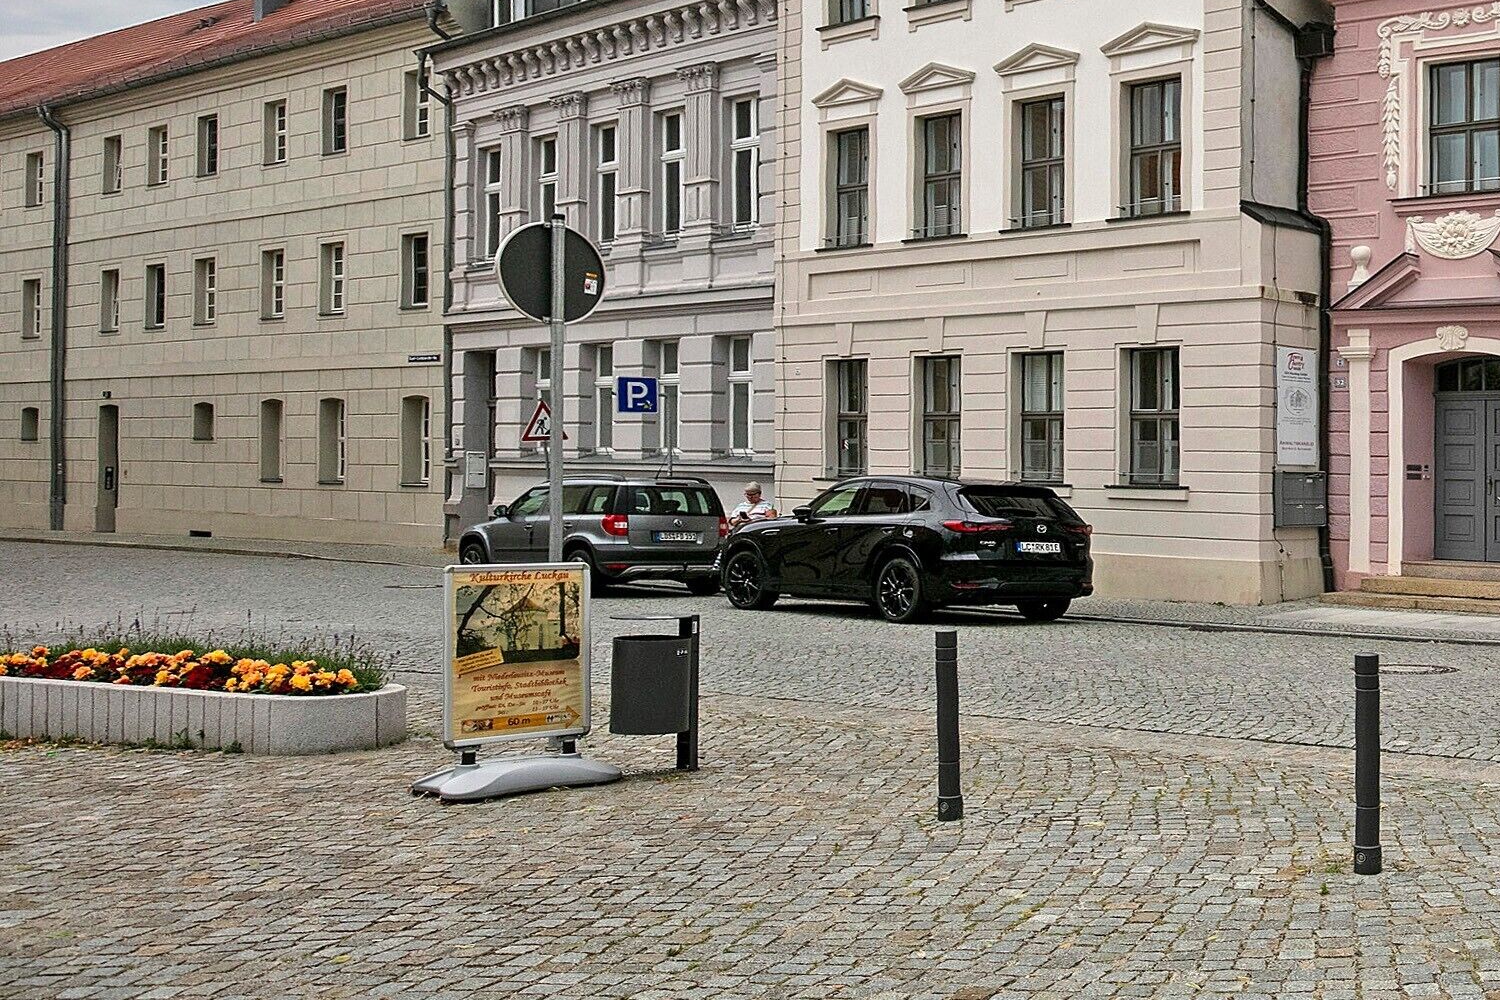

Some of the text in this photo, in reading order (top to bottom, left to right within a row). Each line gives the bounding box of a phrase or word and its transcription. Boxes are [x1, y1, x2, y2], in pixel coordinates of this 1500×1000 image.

[627, 381, 649, 409] P
[469, 569, 570, 583] Kulturkirche Luckau
[473, 673, 485, 682] mit
[490, 692, 504, 701] und
[507, 717, 520, 726] 60
